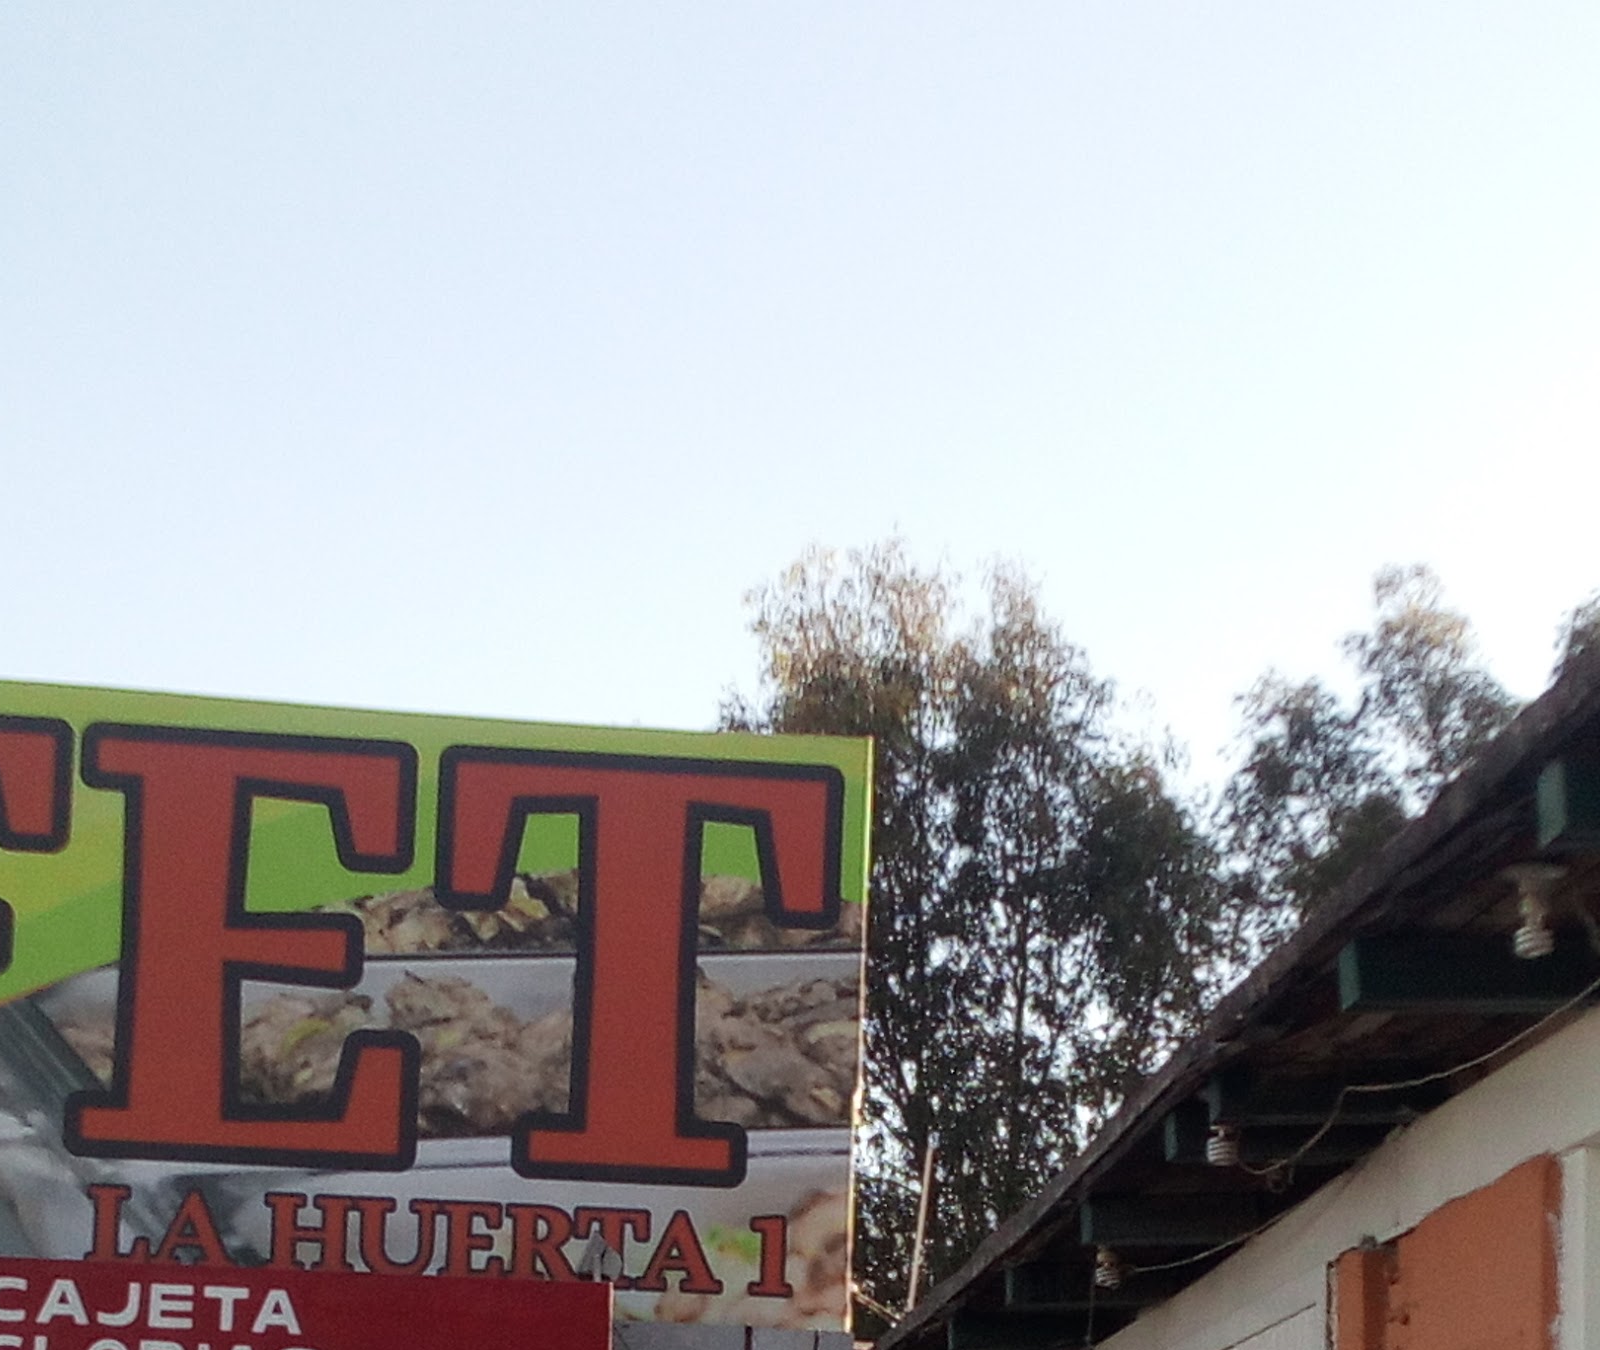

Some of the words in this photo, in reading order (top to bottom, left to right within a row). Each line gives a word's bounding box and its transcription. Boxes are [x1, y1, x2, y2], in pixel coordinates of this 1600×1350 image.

[85, 1183, 235, 1266] LA
[262, 1192, 722, 1295] HUERTA
[748, 1214, 793, 1298] 1
